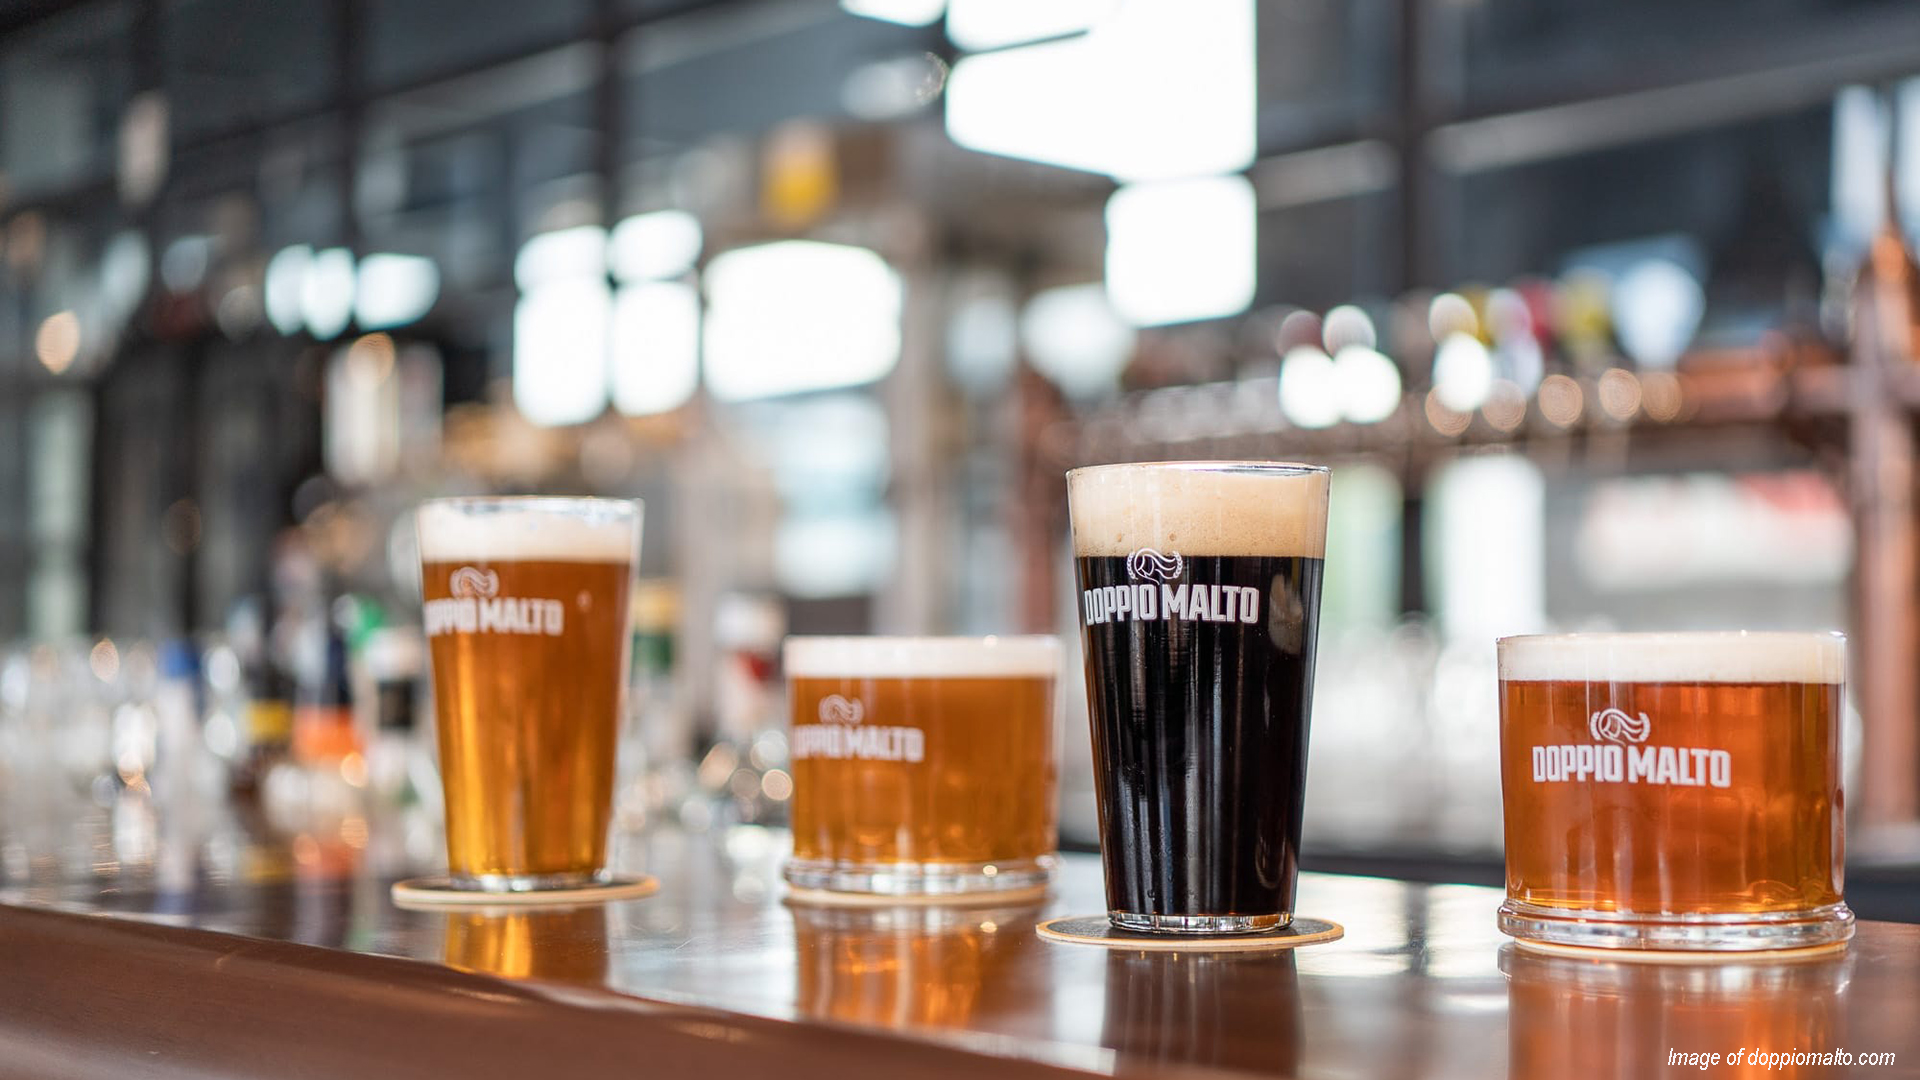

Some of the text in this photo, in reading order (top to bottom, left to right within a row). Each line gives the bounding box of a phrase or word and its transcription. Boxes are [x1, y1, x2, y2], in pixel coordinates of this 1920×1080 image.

[479, 597, 564, 635] MALTO
[1084, 584, 1259, 625] DOPPIO MALTO
[844, 725, 925, 763] MALTO
[1532, 745, 1731, 788] DOPPIO MALTO
